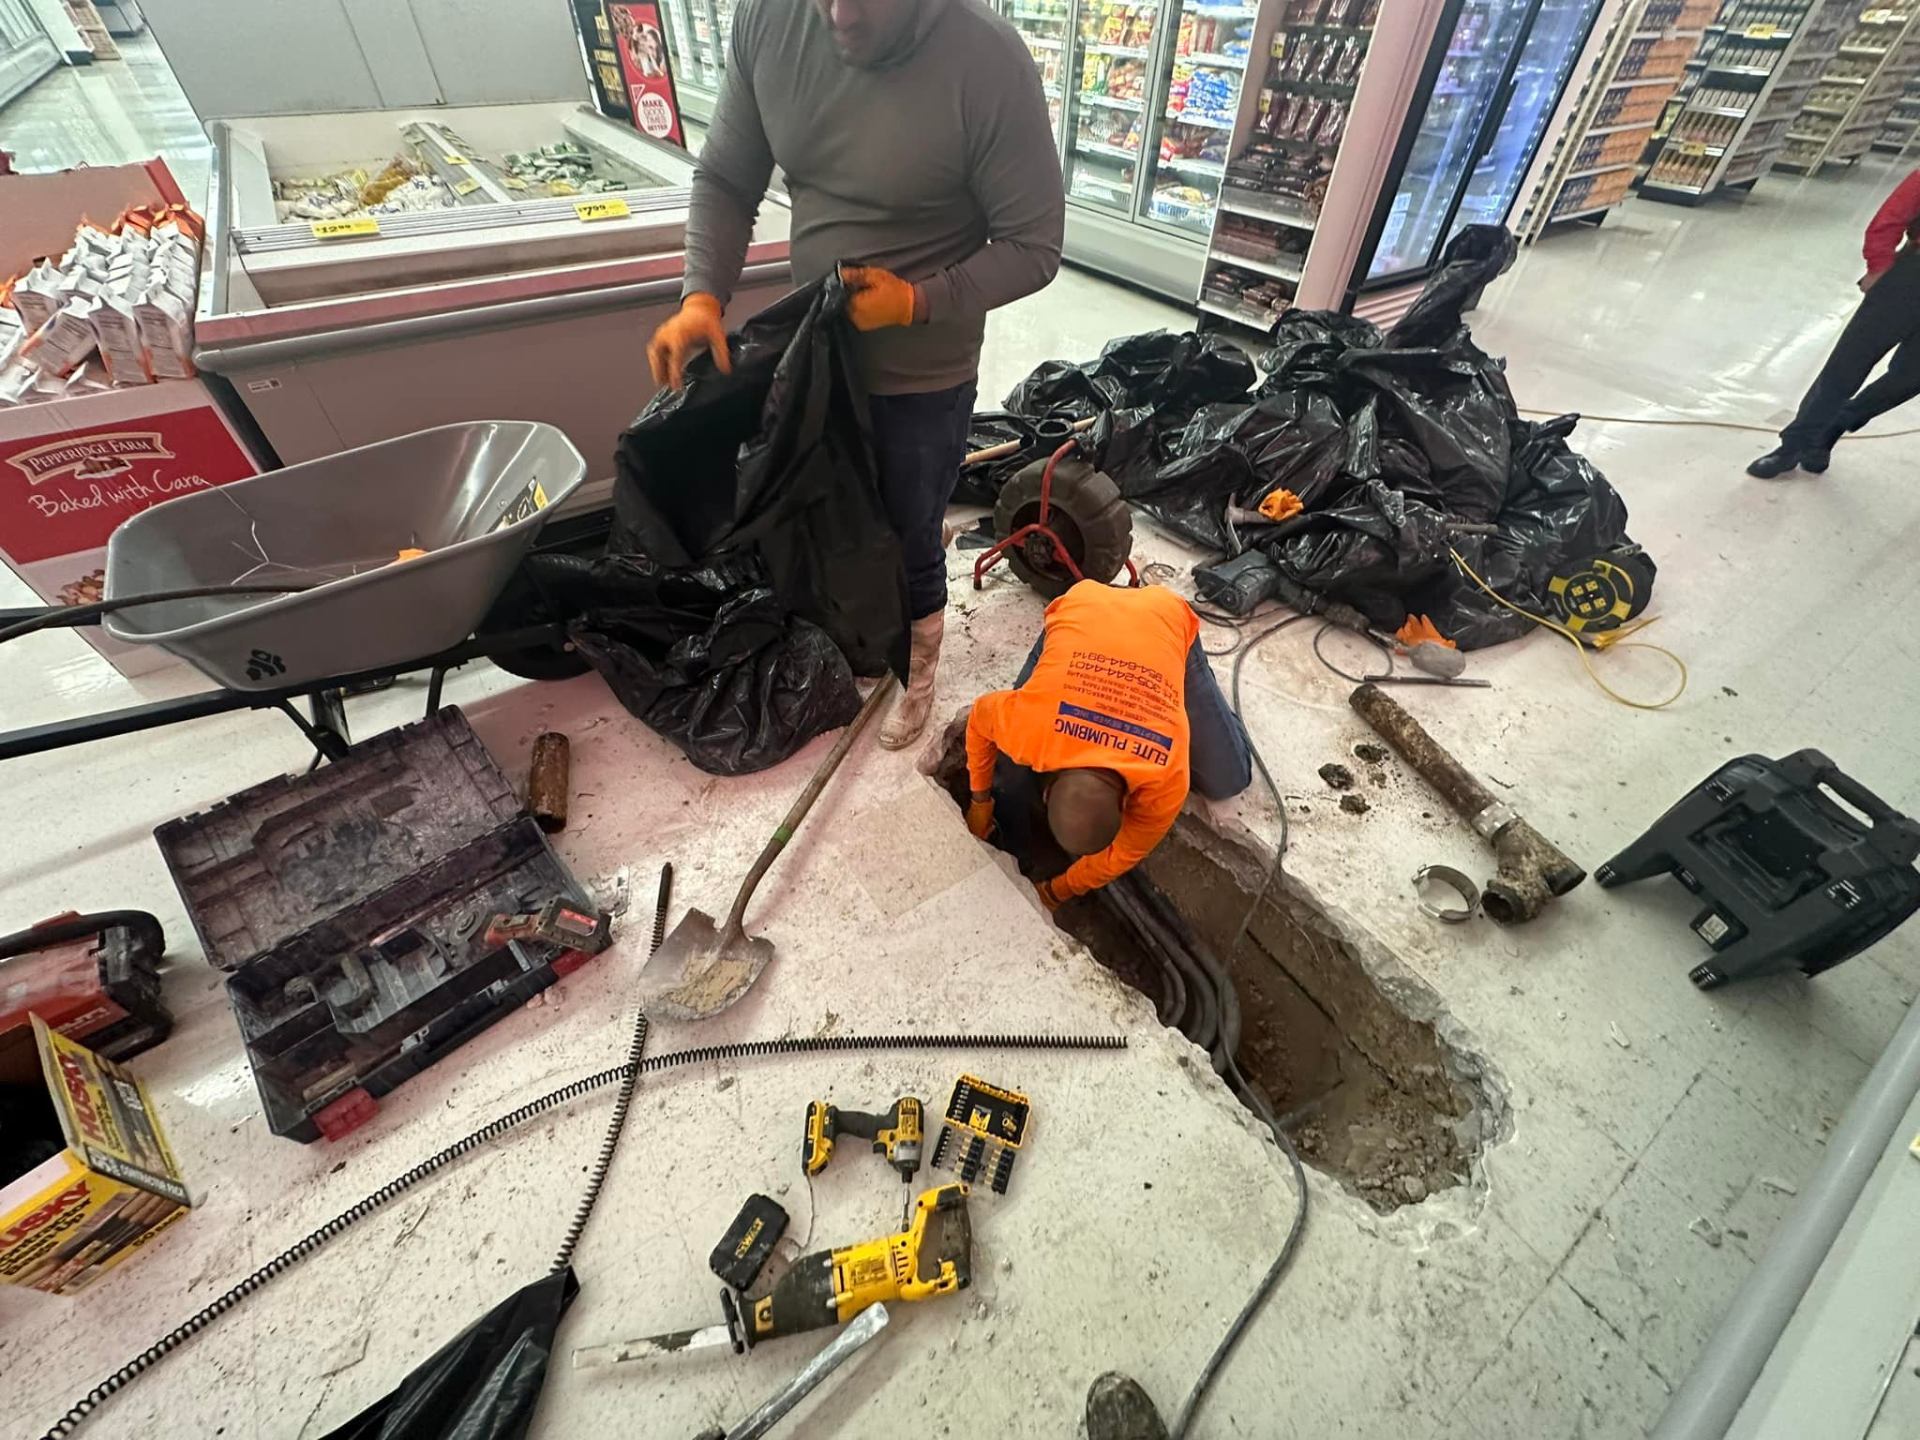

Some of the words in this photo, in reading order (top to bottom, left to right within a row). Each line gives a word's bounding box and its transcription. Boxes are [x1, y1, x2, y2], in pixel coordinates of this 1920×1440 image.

[28, 442, 107, 472] PEPPERIDGE
[108, 439, 152, 454] FARM
[28, 484, 108, 517] Baked
[107, 474, 153, 502] with
[152, 469, 206, 493] Care
[1069, 660, 1161, 694] 305-244-4401
[1055, 718, 1128, 751] PLUMBING
[1130, 741, 1169, 766] ELITE
[56, 1045, 106, 1145] HUSKY
[0, 1179, 91, 1252] USKY
[0, 1198, 91, 1263] ontractor
